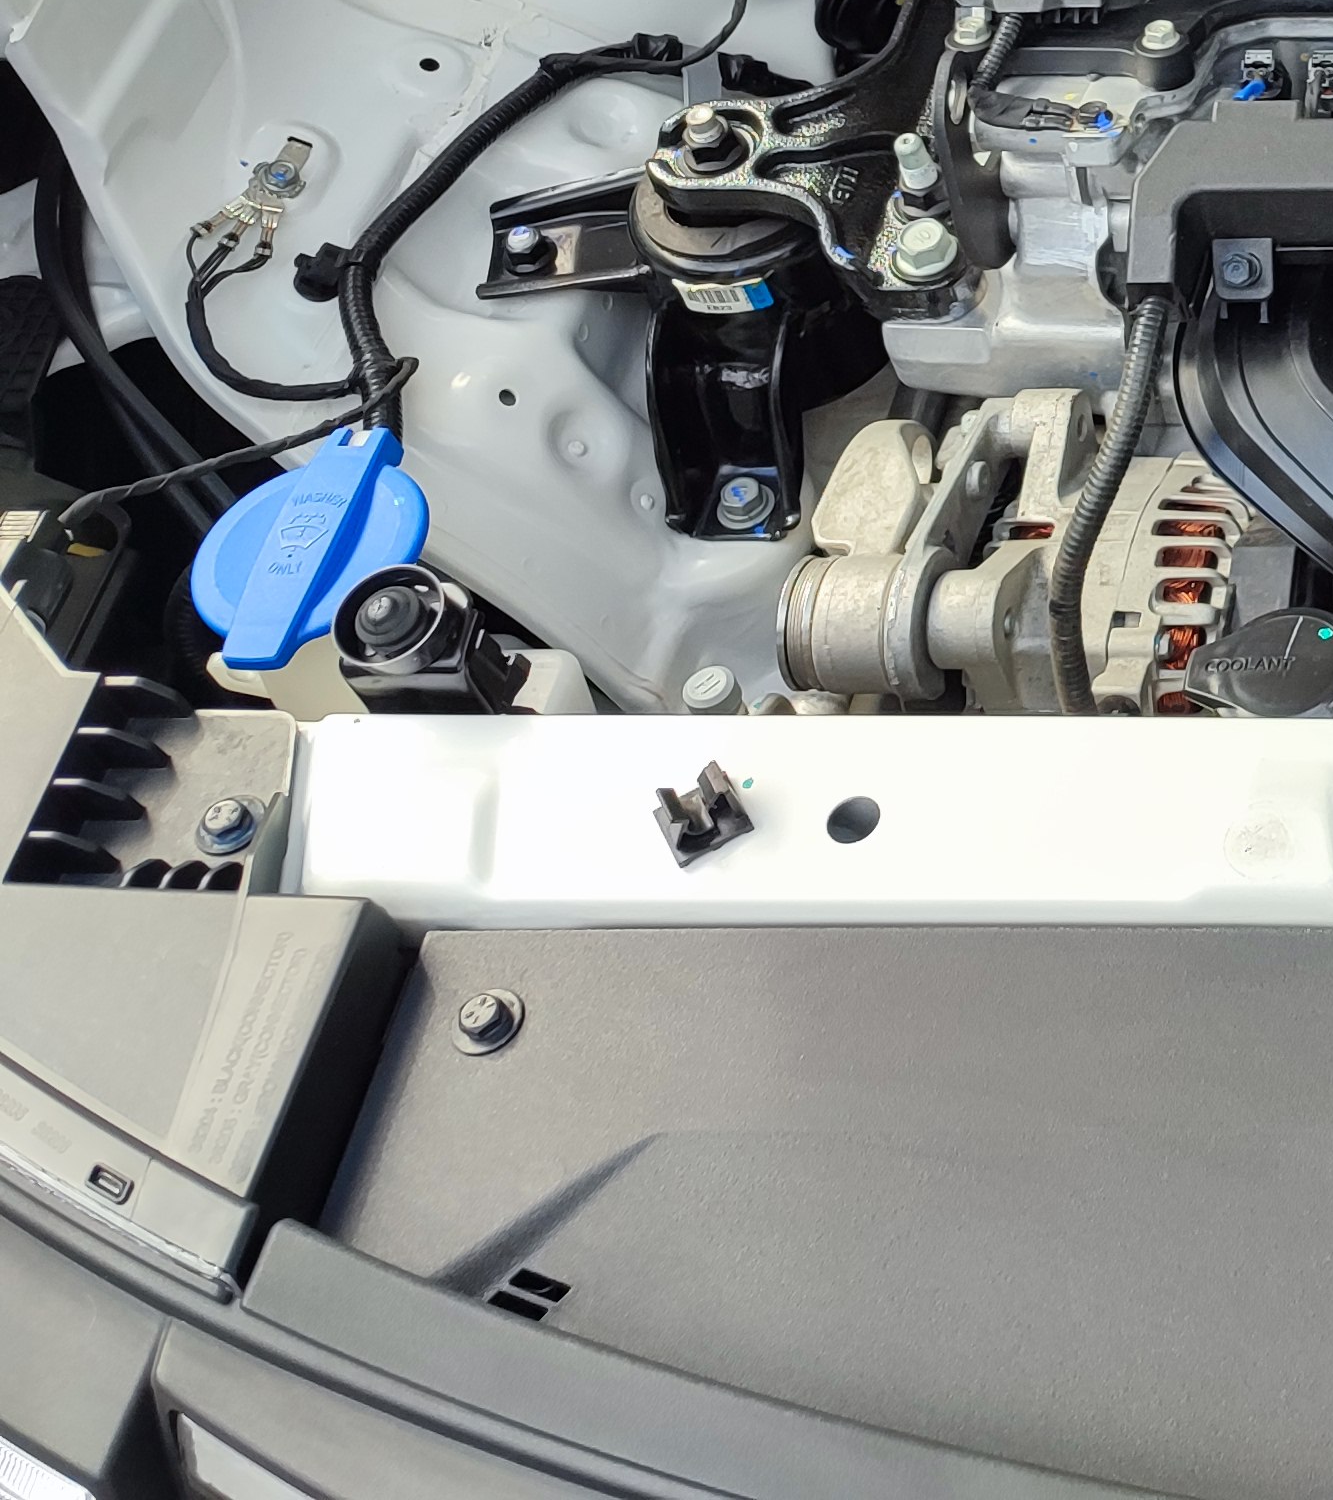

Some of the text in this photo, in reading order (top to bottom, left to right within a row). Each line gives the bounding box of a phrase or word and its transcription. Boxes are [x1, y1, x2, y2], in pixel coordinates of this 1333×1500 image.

[291, 491, 347, 509] WASHER
[267, 561, 302, 575] ONLY
[1205, 655, 1296, 673] COOLANT
